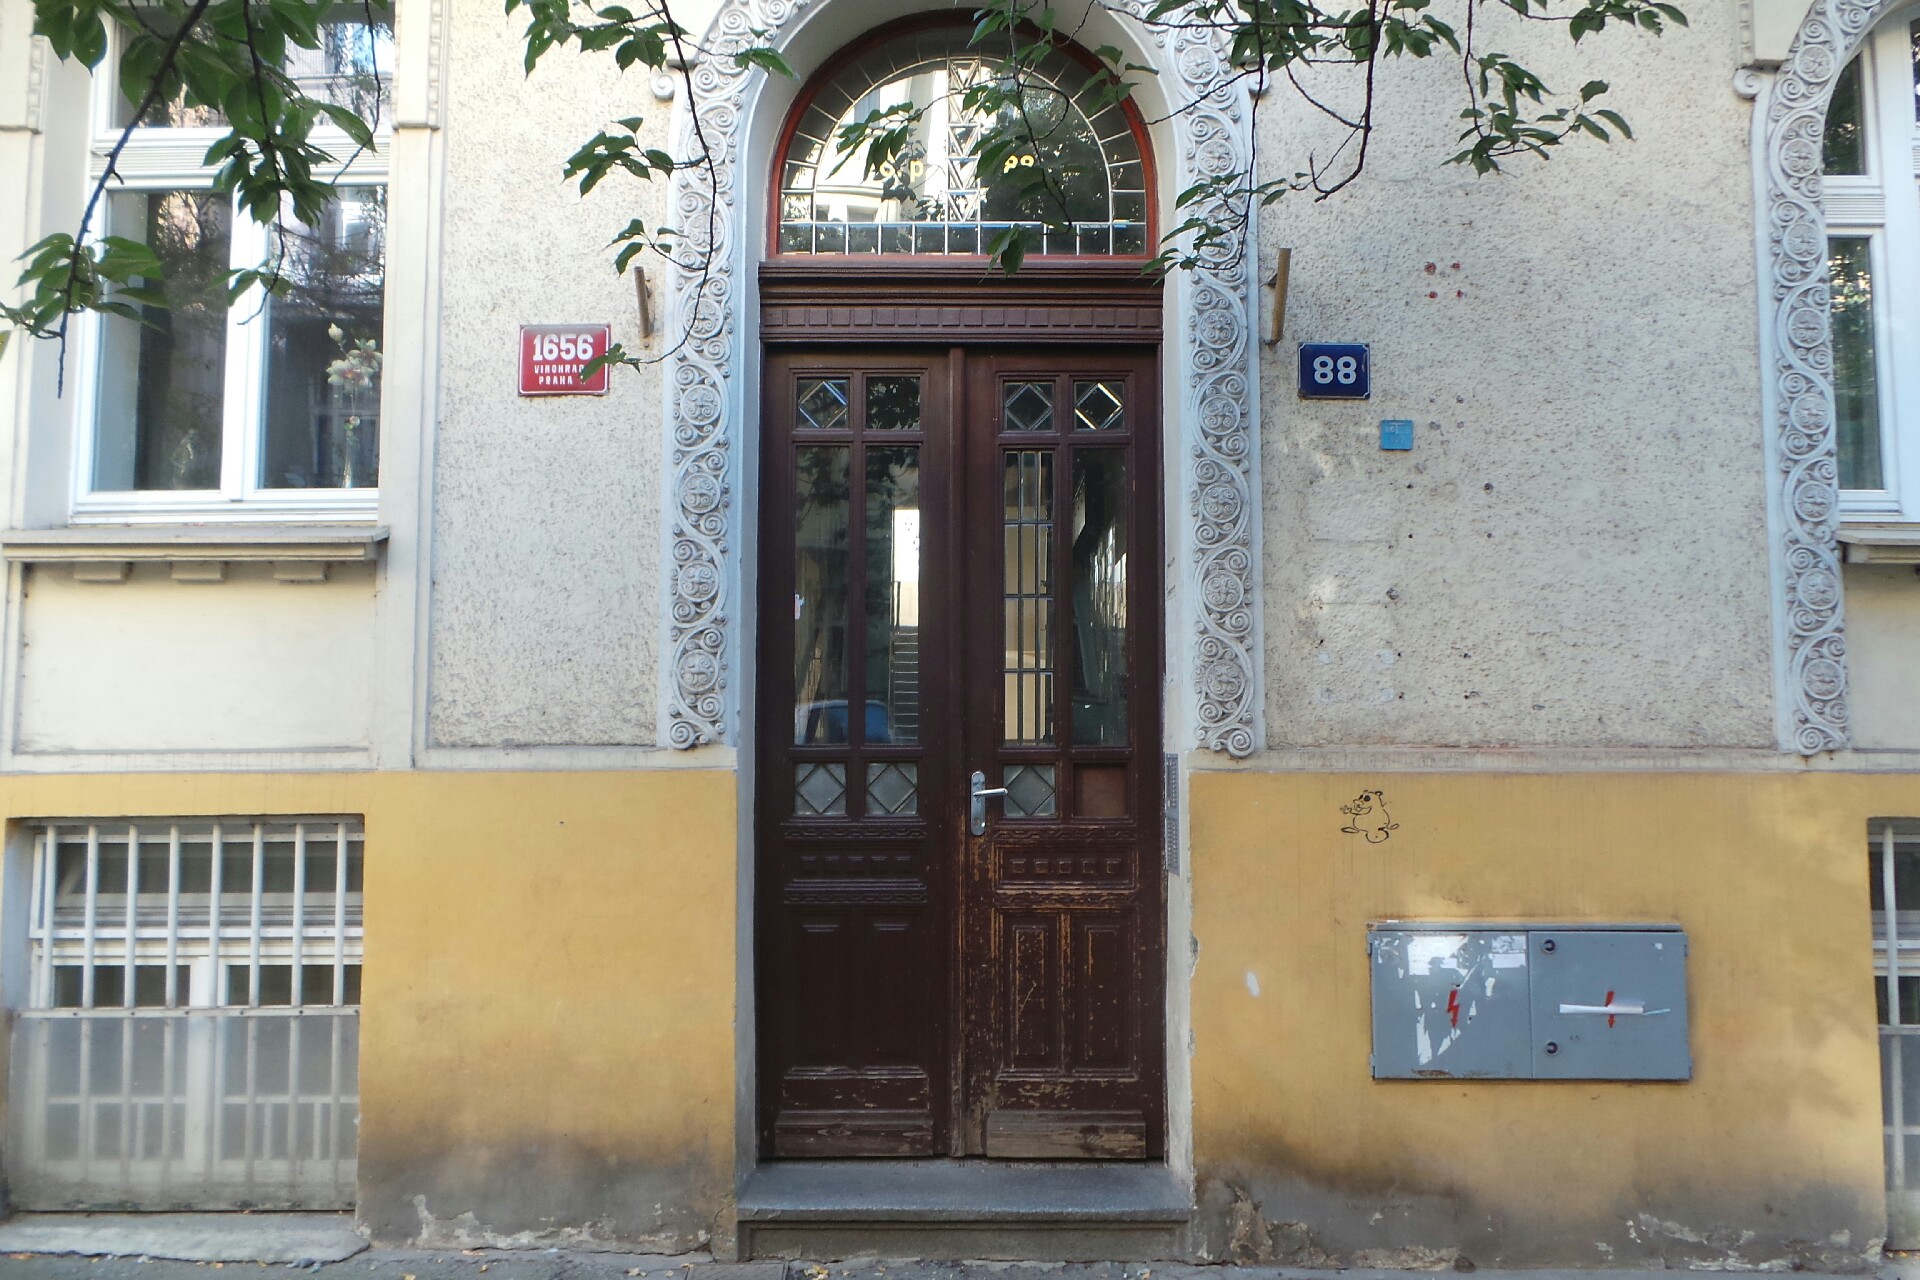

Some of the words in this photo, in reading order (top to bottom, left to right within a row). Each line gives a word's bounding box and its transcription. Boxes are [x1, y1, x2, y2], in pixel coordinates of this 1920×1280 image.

[533, 333, 593, 361] 1656
[534, 364, 586, 374] VINOHRAD
[1313, 355, 1357, 384] 88
[538, 375, 573, 385] PRAHA
